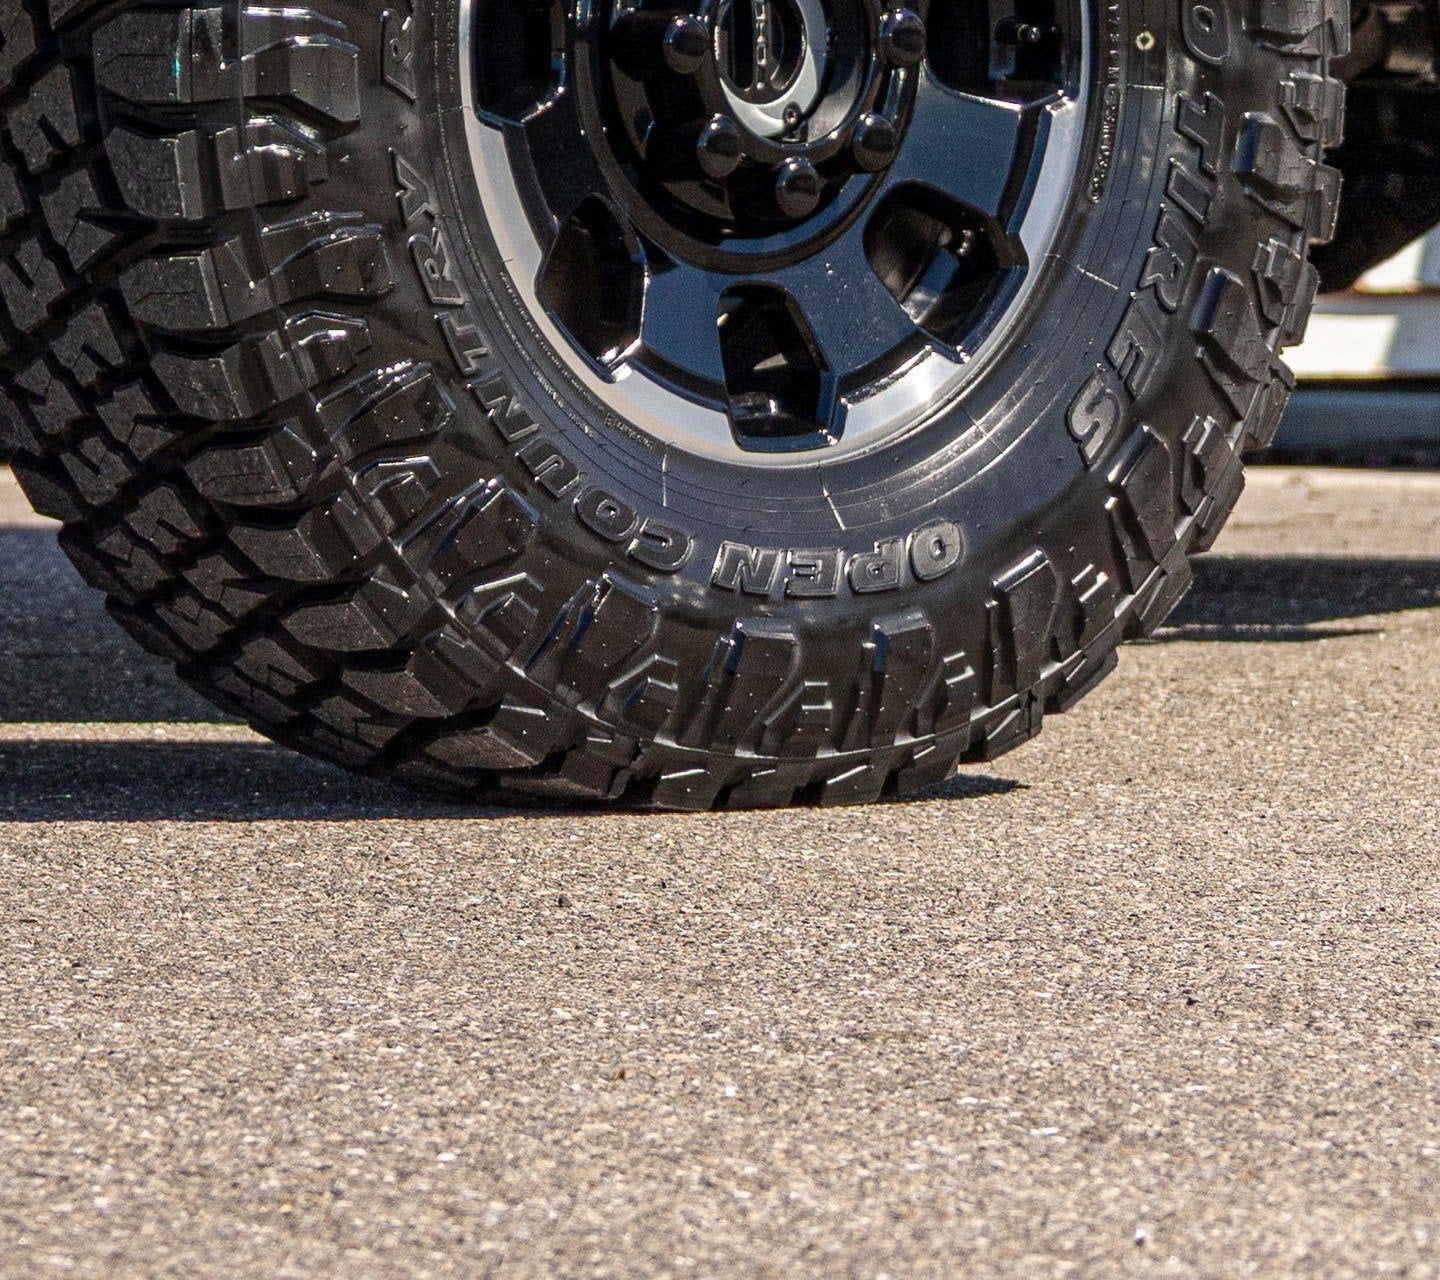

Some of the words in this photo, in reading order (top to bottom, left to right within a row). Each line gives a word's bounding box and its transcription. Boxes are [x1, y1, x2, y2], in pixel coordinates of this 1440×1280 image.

[388, 146, 696, 574] COUNTRY
[1066, 90, 1227, 469] TIRES
[711, 516, 967, 598] OPEN
